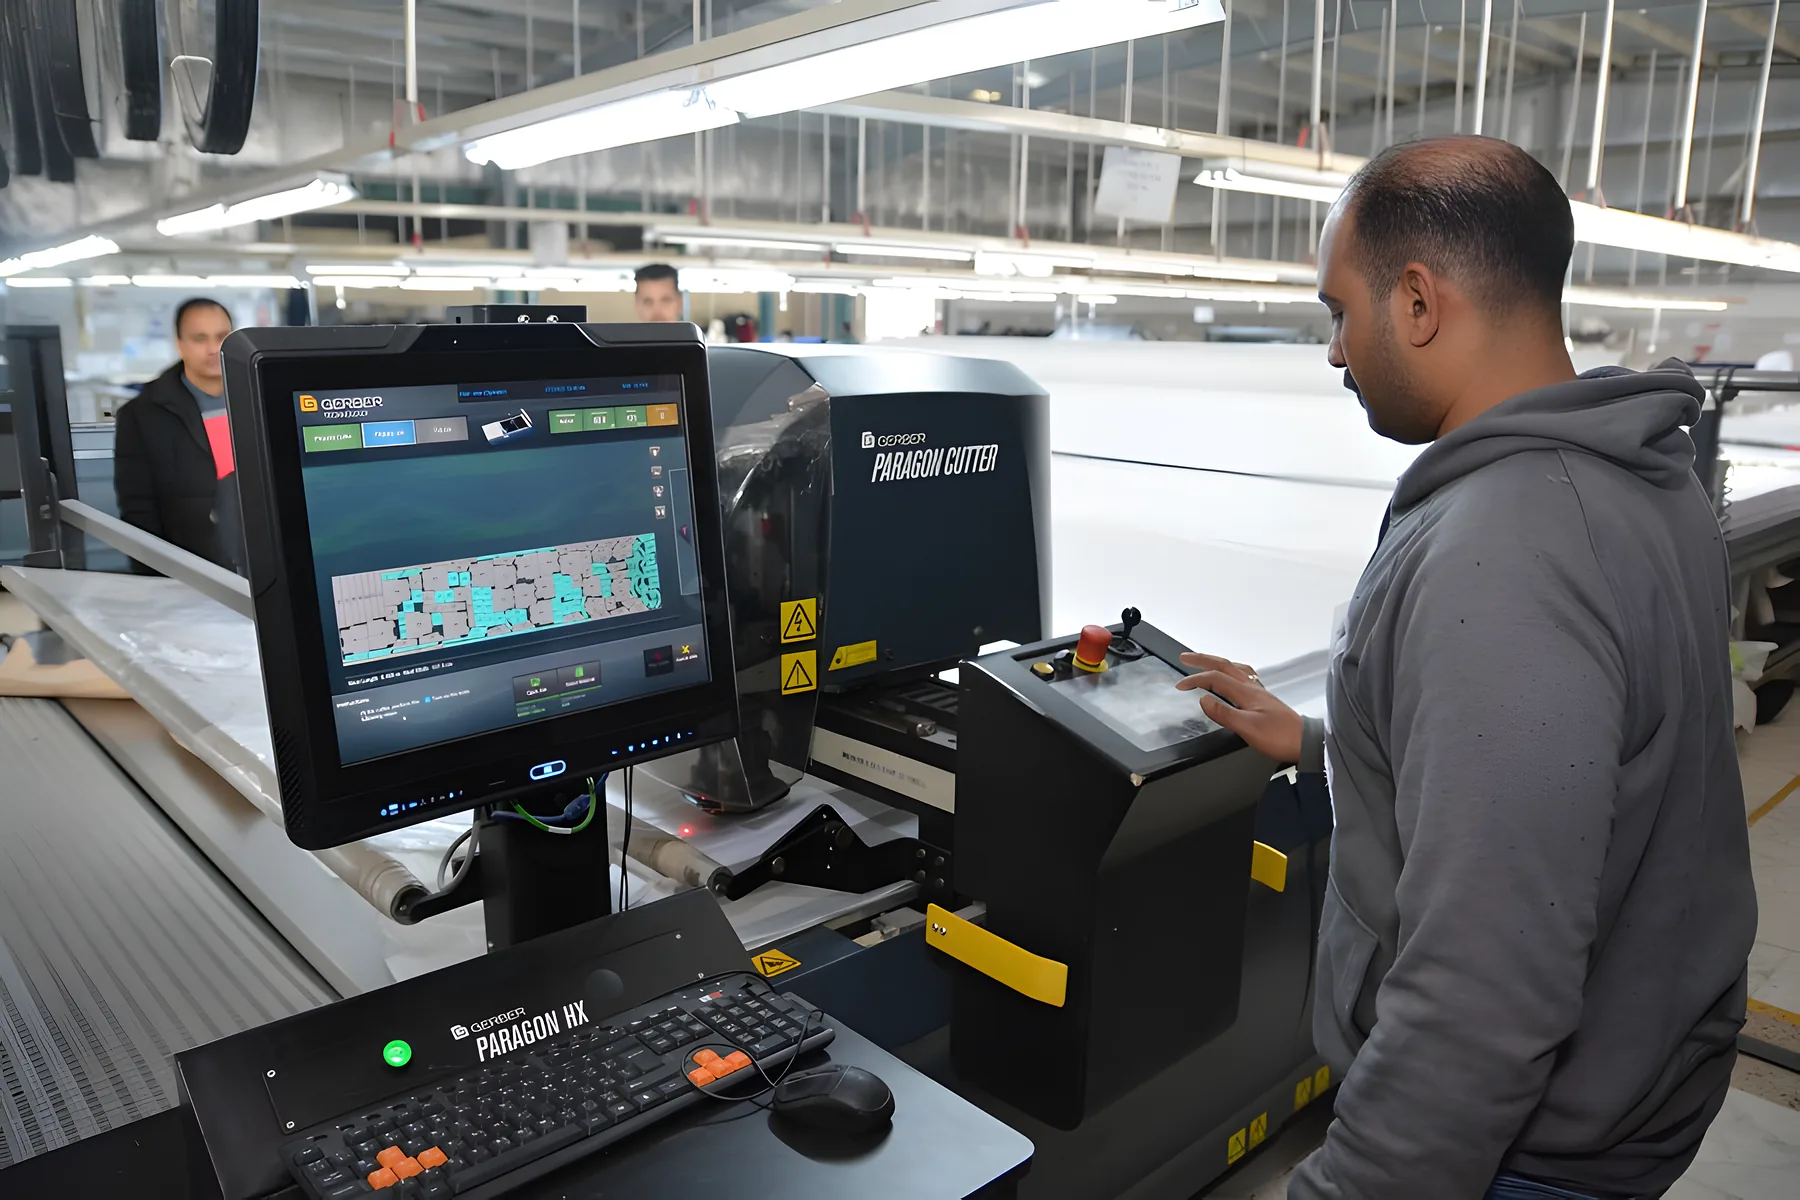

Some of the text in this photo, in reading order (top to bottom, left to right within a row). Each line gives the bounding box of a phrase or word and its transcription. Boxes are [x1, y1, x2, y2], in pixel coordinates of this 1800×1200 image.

[871, 444, 999, 483] PARAGON CUTTER
[470, 1007, 527, 1033] GERBER
[476, 999, 590, 1062] PARAGON HX
